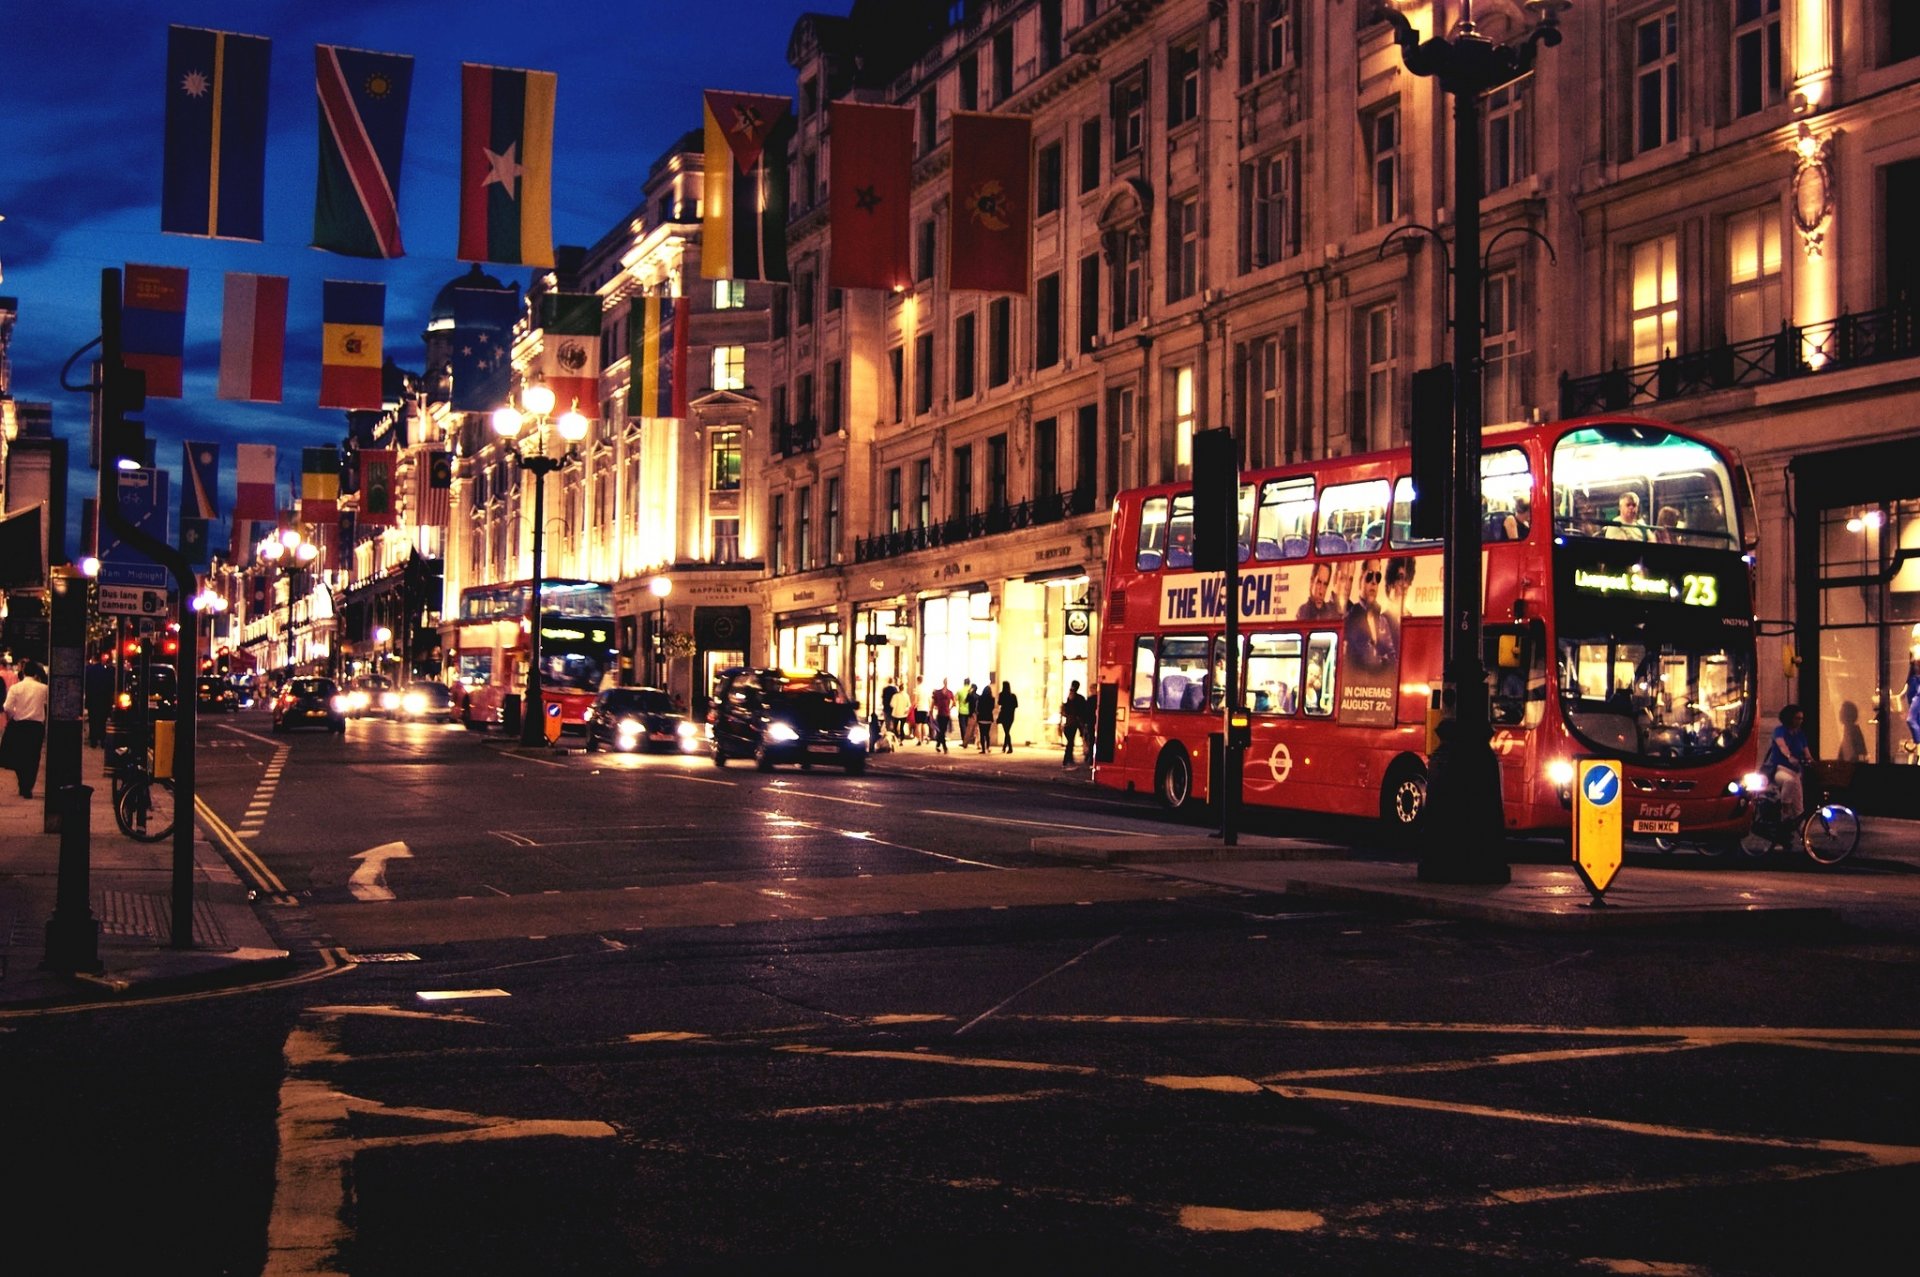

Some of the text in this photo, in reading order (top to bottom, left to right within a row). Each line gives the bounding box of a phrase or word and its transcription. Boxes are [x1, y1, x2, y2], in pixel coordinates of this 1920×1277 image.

[102, 589, 138, 600] Bus lane
[1683, 574, 1717, 607] 23
[102, 601, 137, 610] cameras
[1167, 587, 1198, 619] THE
[1344, 686, 1392, 699] IN CINEMAS
[1341, 698, 1375, 711] AUGUST
[1640, 802, 1664, 817] First
